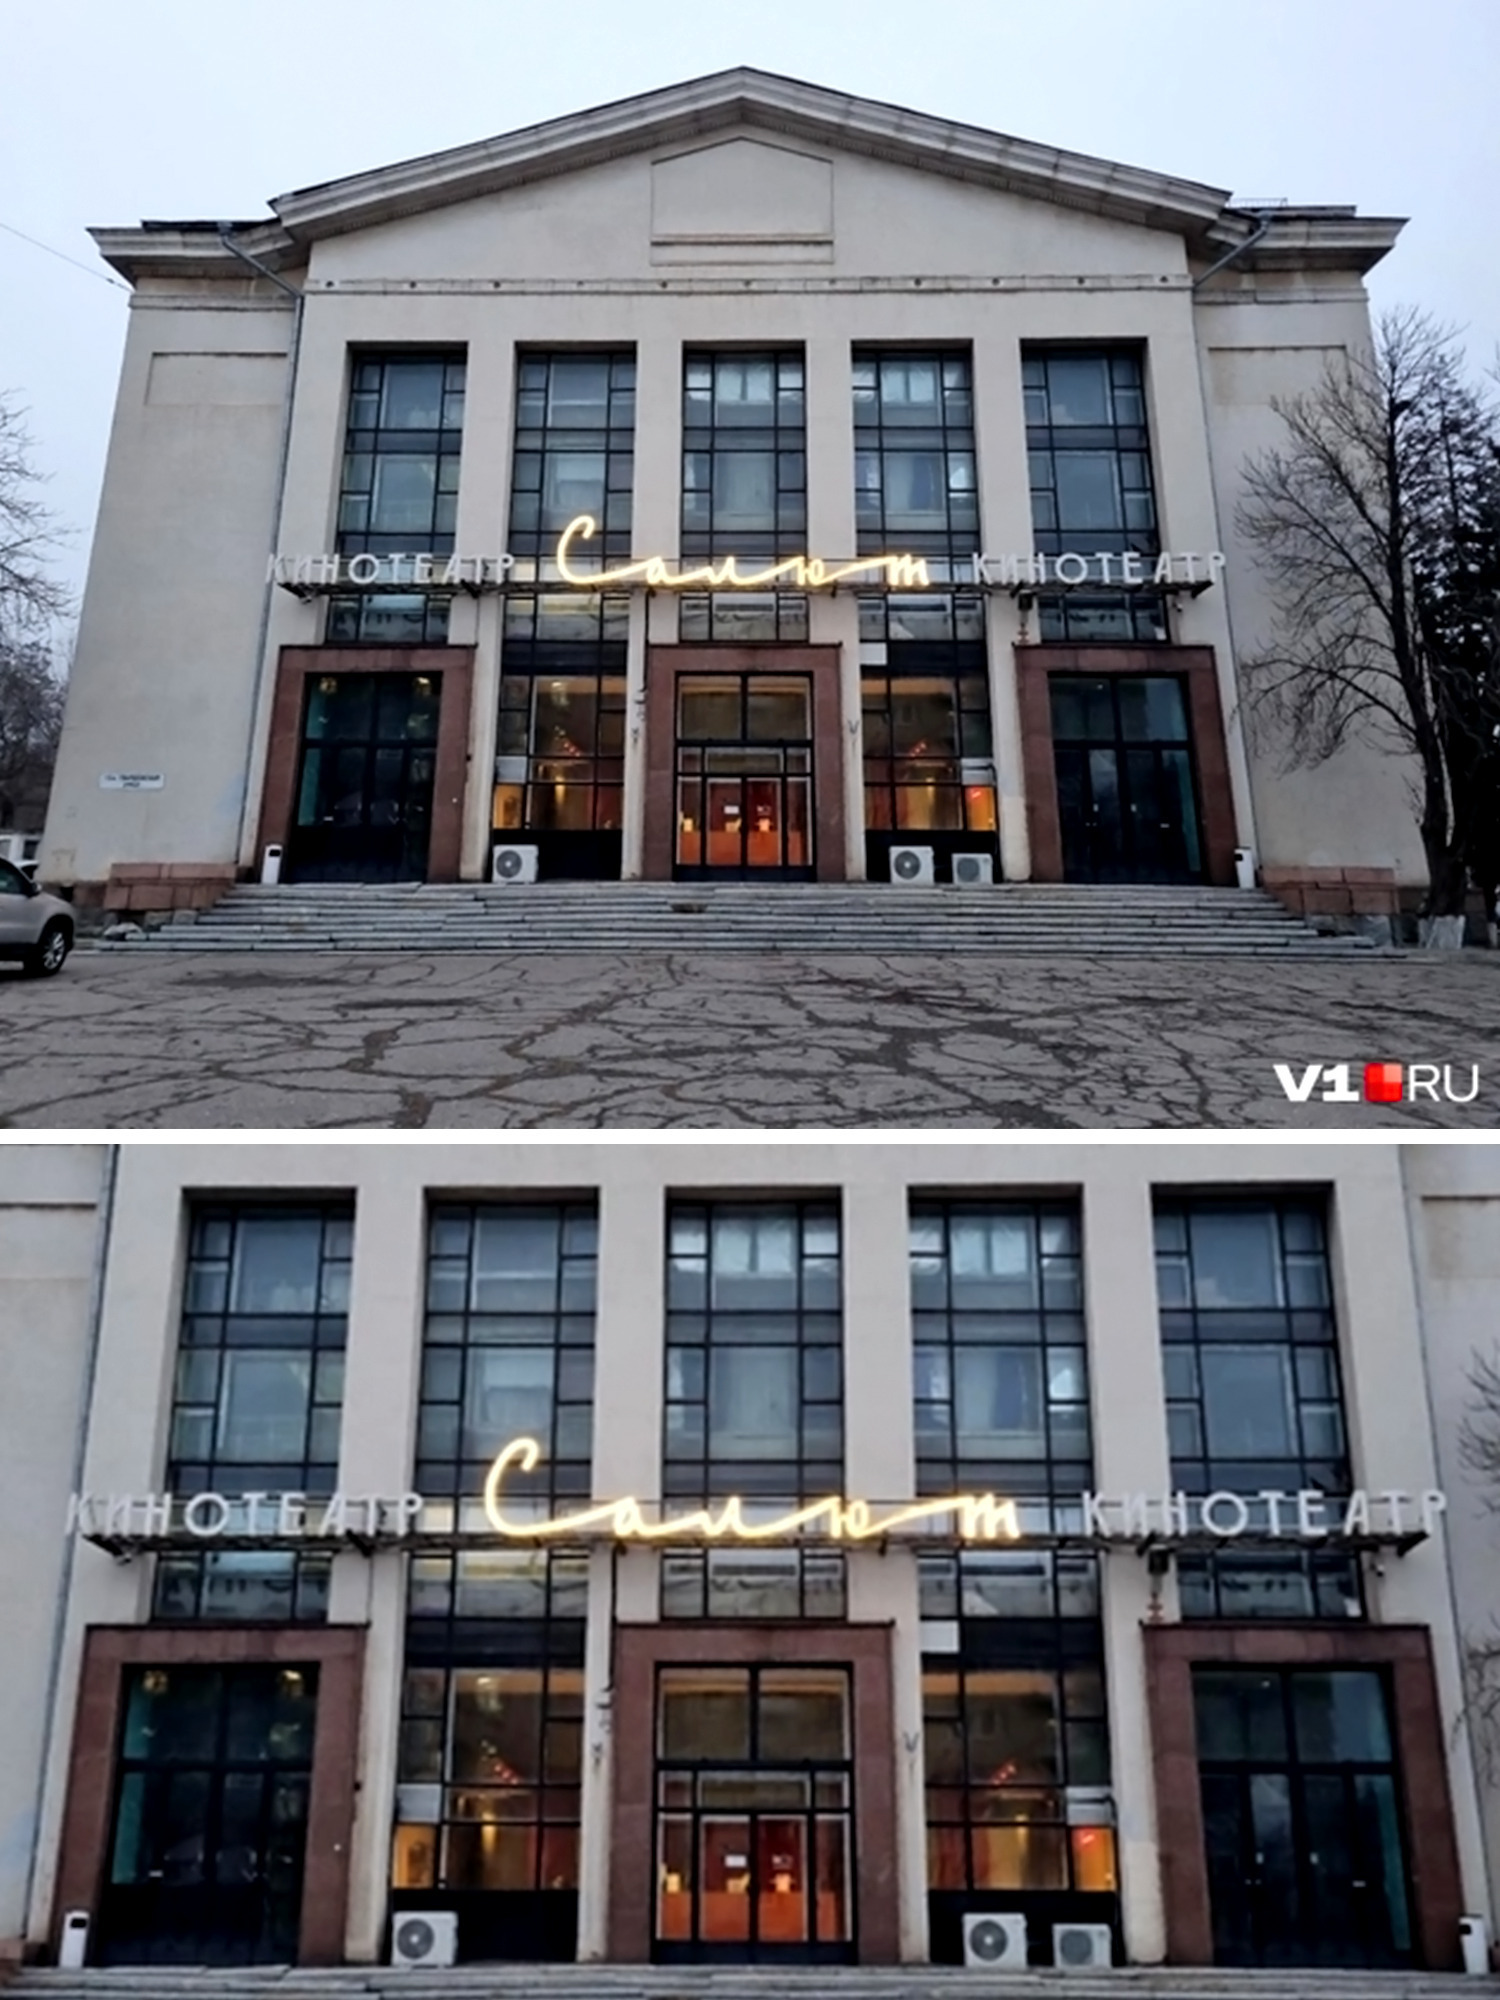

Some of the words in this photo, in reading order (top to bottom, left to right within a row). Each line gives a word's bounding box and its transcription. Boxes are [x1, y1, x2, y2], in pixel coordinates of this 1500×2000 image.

[265, 552, 515, 585] КИНОТЕАТР
[556, 515, 930, 587] Салют
[972, 551, 1227, 585] КИНОТЕАТР
[65, 1491, 424, 1537] КИНОТЕАТР
[484, 1437, 1021, 1539] Салют
[1081, 1489, 1447, 1538] КИНОТЕАТР
